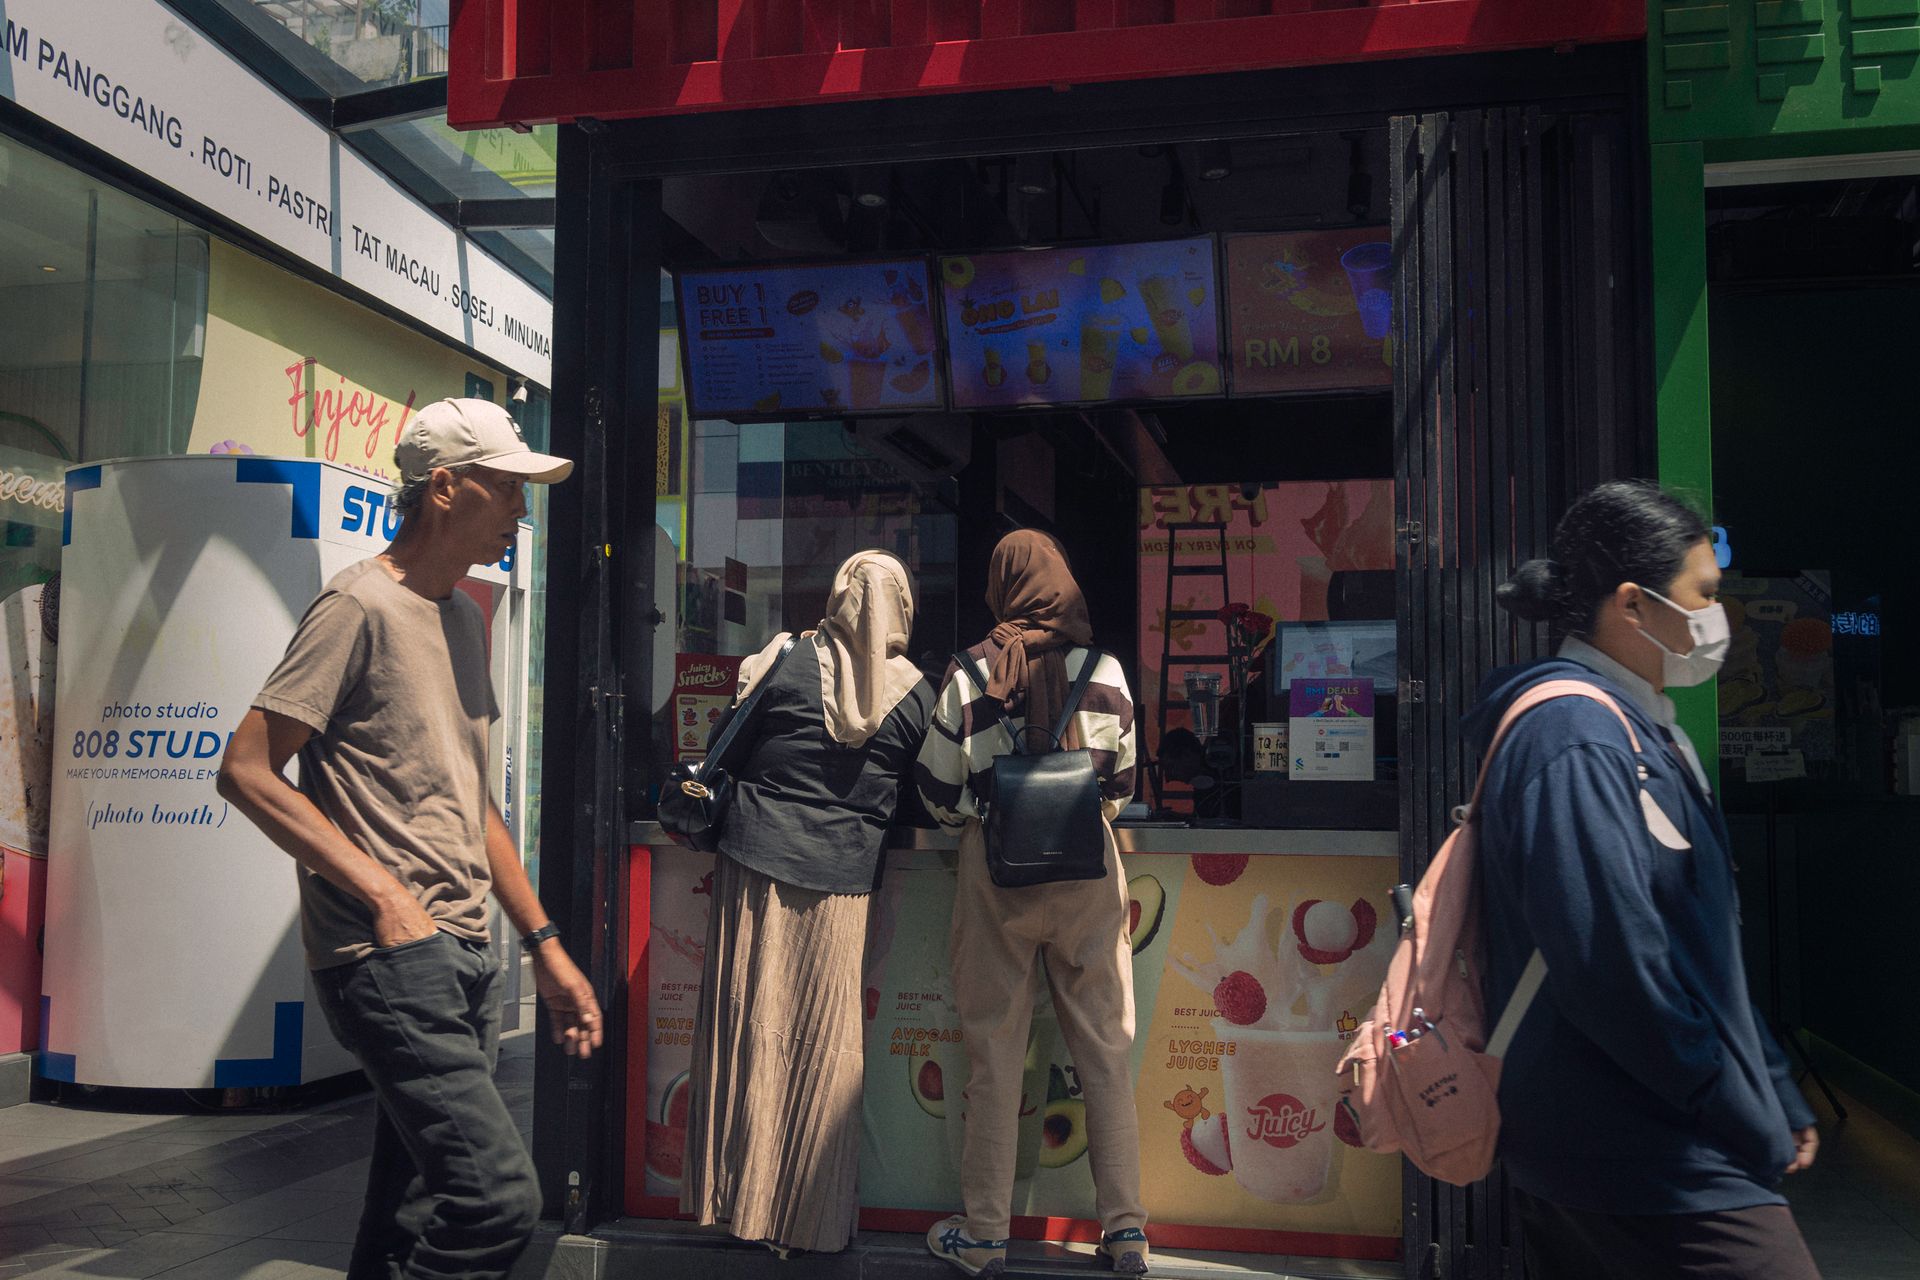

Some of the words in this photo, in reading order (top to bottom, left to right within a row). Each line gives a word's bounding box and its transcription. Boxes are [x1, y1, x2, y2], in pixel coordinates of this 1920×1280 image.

[0, 18, 28, 61] M
[38, 38, 182, 148] PANGGANG
[202, 136, 251, 189] ROTI
[268, 175, 333, 236] PASTRI
[352, 225, 381, 262] TAT
[386, 244, 440, 296] MACAU
[451, 284, 494, 327] SOSEJ
[697, 283, 745, 305] BUY
[753, 282, 766, 304] 1
[700, 307, 751, 326] FREE
[758, 305, 768, 325] 1
[1245, 336, 1300, 368] RM
[1310, 335, 1332, 364] 8
[285, 356, 390, 461] Enjoy
[688, 663, 711, 674] Juicy
[678, 667, 729, 688] Snacks
[1327, 686, 1359, 695] DEALS
[102, 702, 151, 722] photo
[156, 702, 218, 719] studio
[72, 729, 120, 758] 808
[1258, 736, 1273, 751] TQ
[66, 768, 89, 779] MAKE
[91, 768, 118, 779] YOUR
[121, 768, 204, 780] MEMORABLE
[661, 983, 682, 991] BEST
[660, 993, 684, 1001] JUICE
[897, 992, 919, 1001] BEST
[921, 992, 943, 1001] MILK
[896, 1003, 922, 1011] JUICE
[1174, 1007, 1197, 1016] BEST
[1199, 1009, 1226, 1018] JUICE
[890, 1042, 931, 1057] MILK
[1168, 1039, 1237, 1056] LYCHEE
[1166, 1055, 1219, 1071] JUICE
[1246, 1105, 1326, 1140] Juicy
